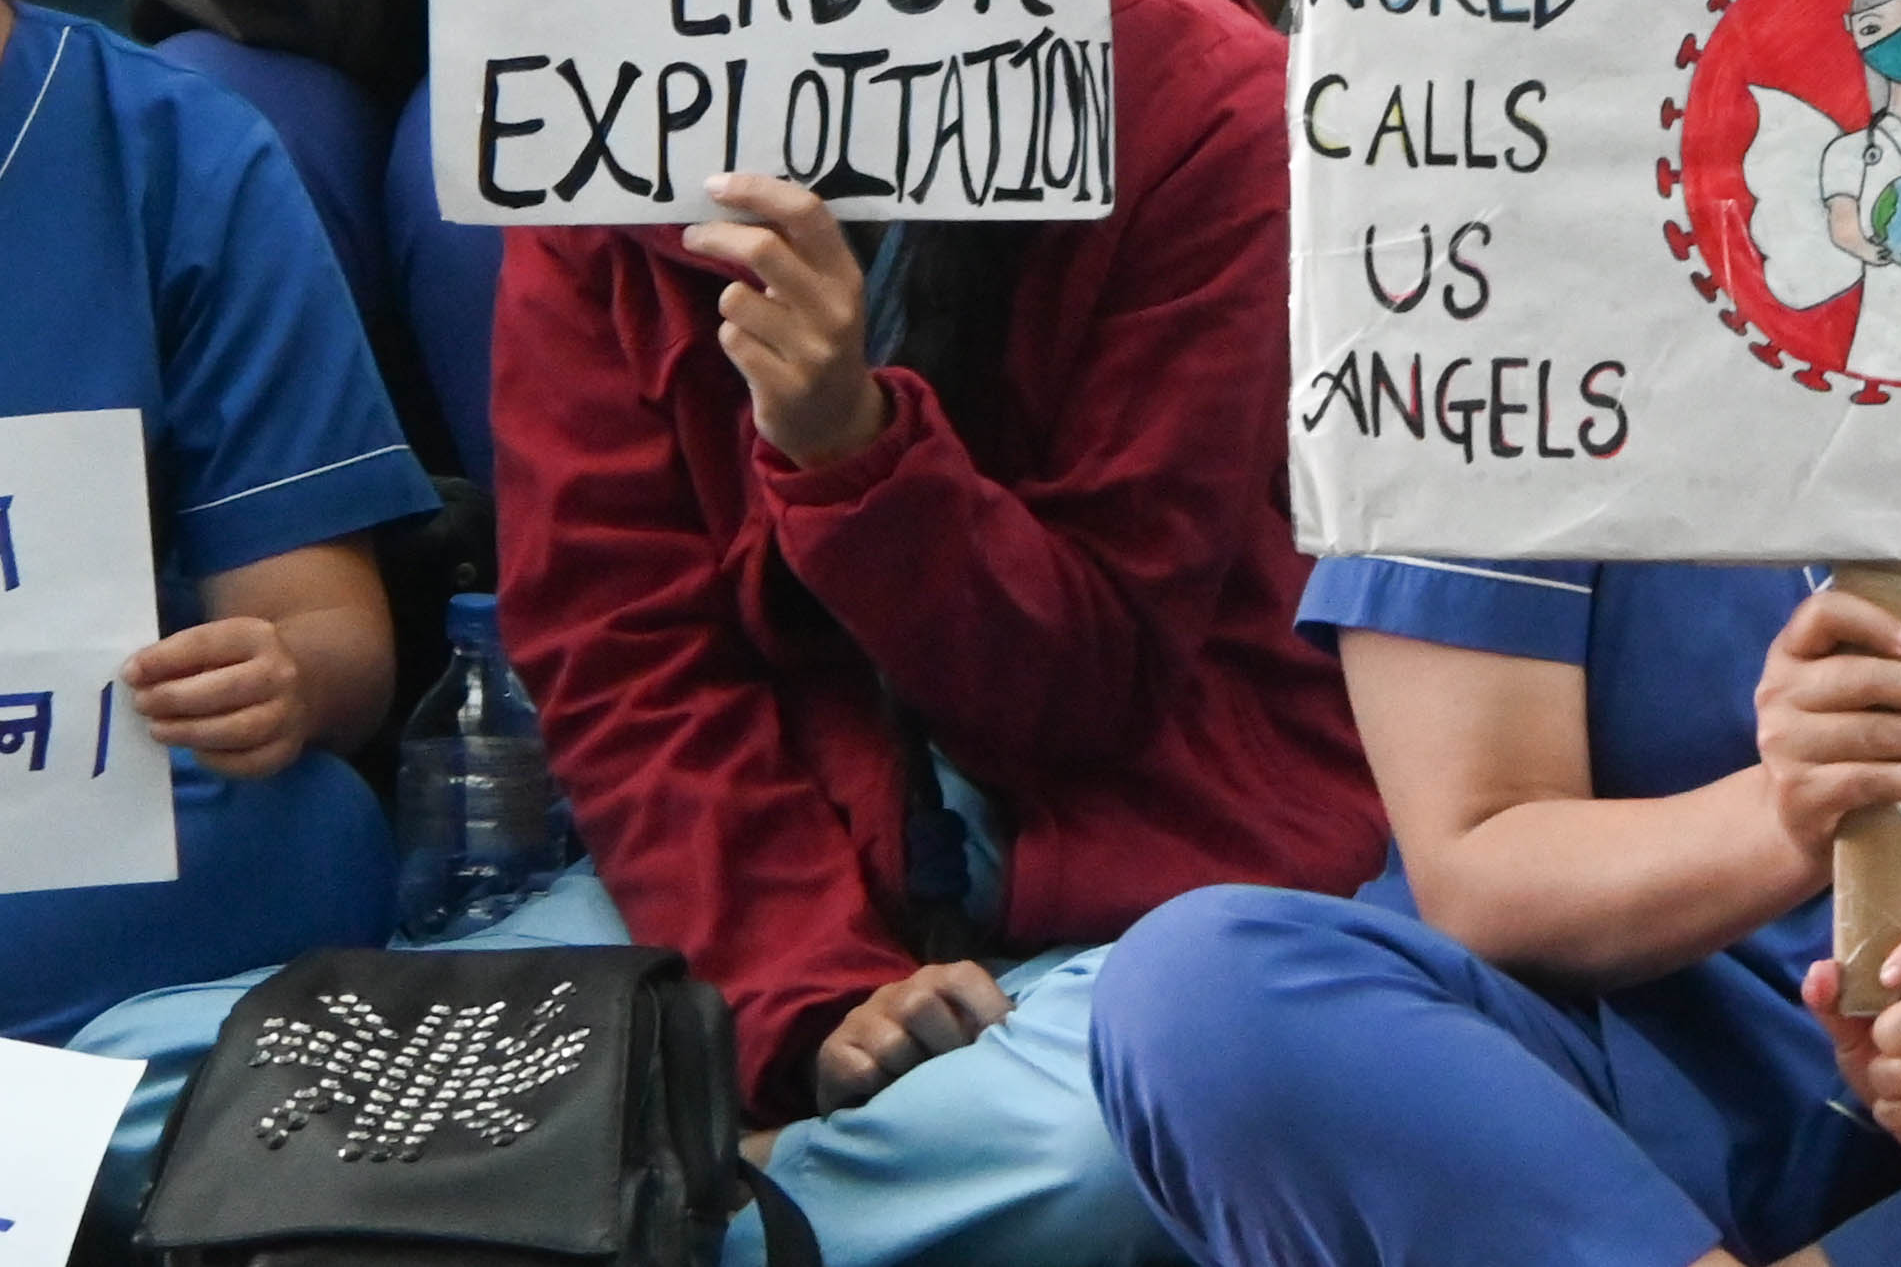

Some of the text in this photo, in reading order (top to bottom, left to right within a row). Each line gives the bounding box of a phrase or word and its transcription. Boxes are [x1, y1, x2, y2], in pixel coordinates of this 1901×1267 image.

[478, 28, 1112, 209] EXPLOITATION
[1303, 74, 1550, 173] CALLS
[1364, 221, 1492, 321] US
[1303, 351, 1631, 464] ANGELS
